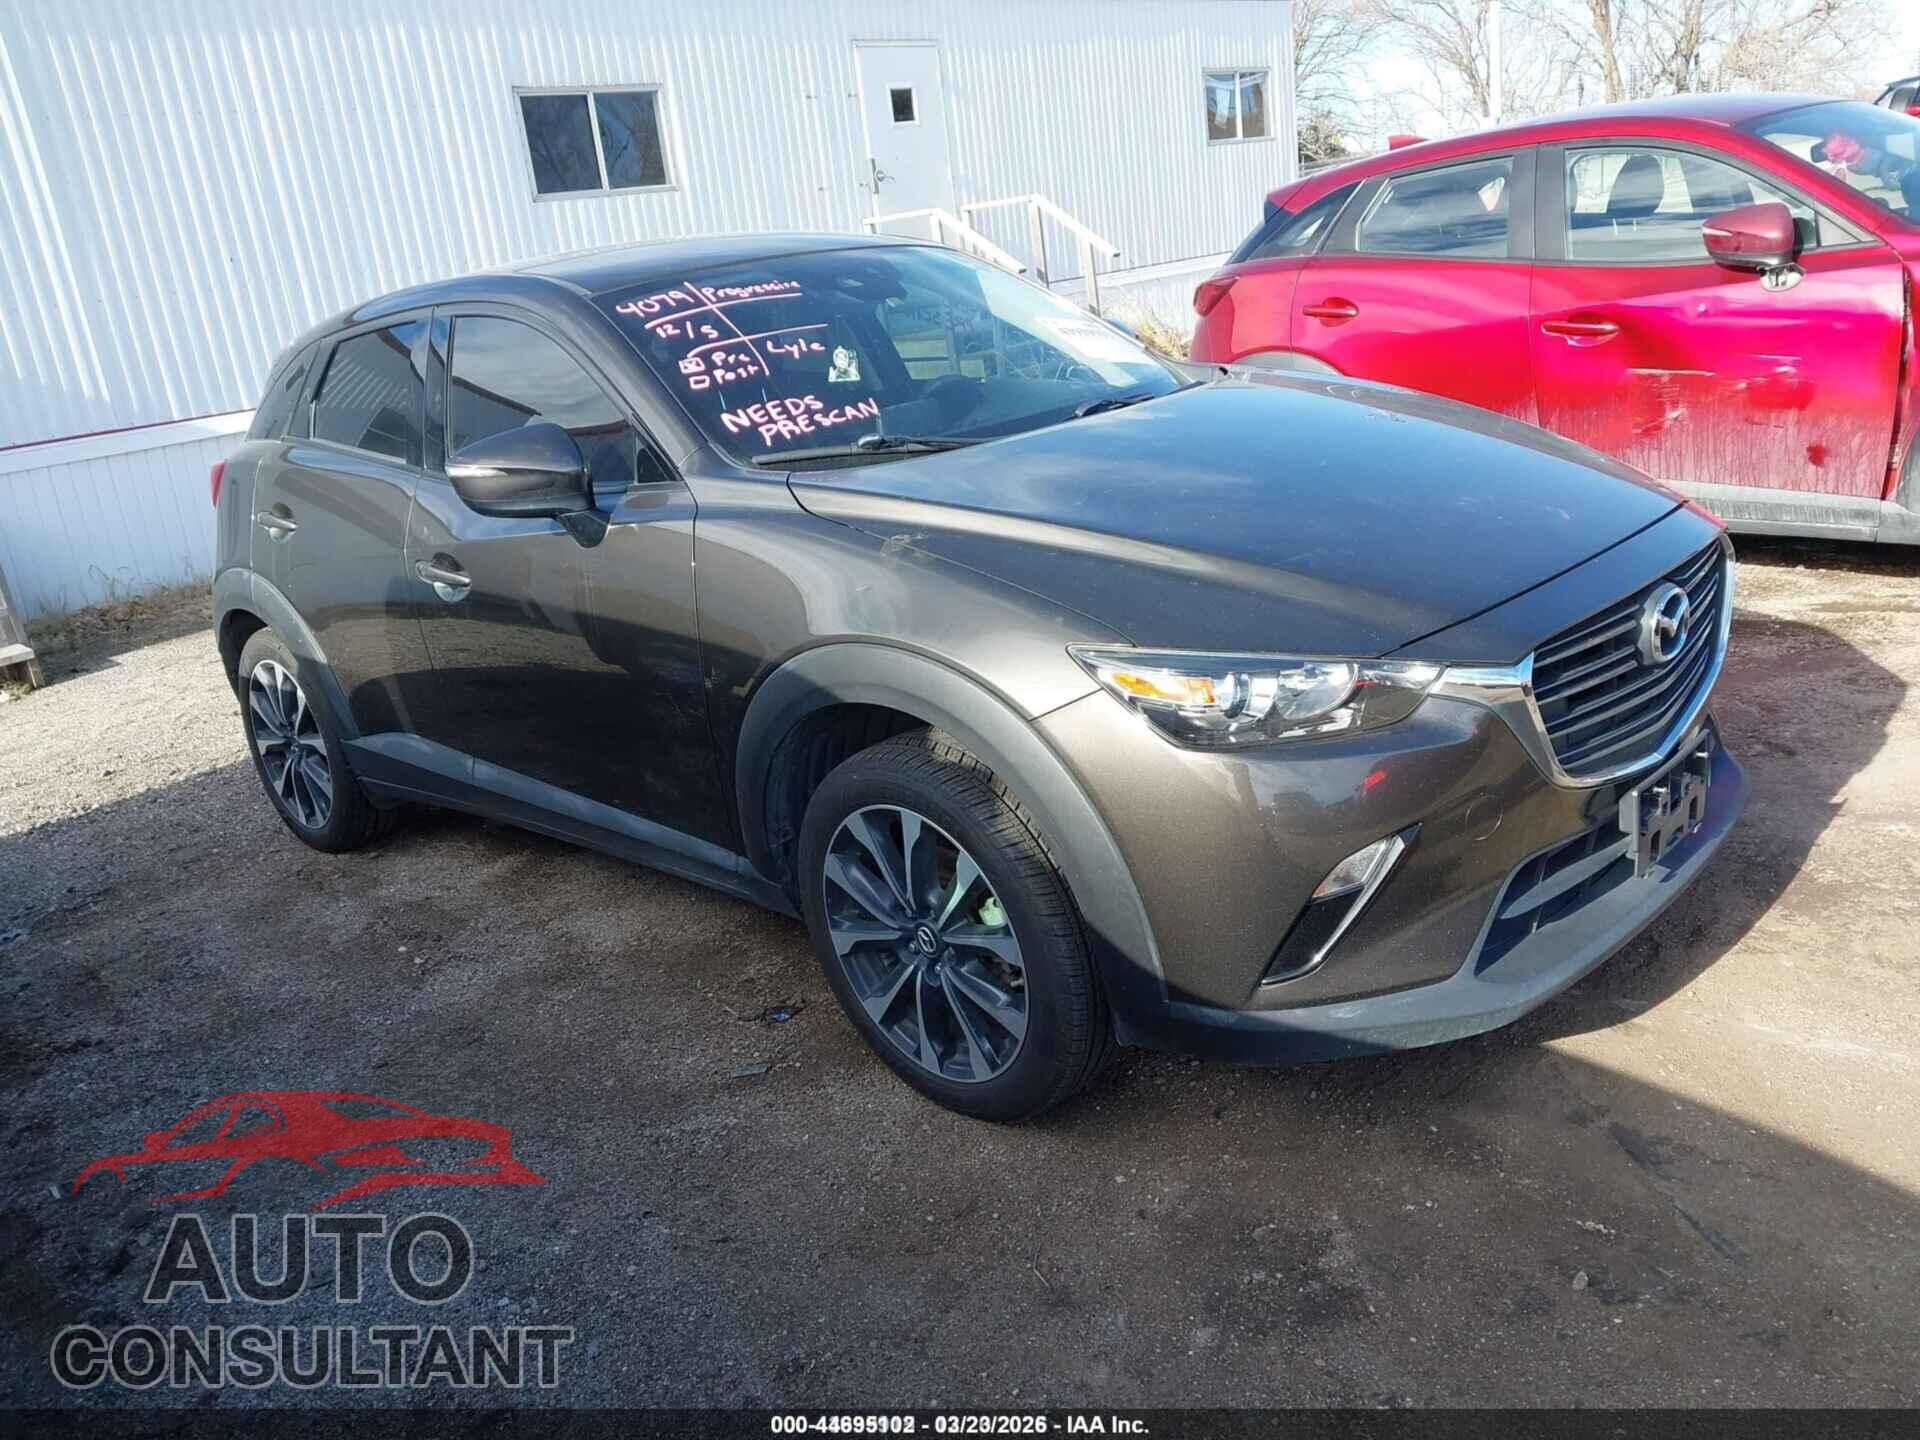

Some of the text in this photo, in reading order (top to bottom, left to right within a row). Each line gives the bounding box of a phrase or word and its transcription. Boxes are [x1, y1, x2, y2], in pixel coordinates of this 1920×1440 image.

[615, 290, 695, 318] 4079
[720, 394, 824, 433] NEEDS
[757, 397, 880, 447] PRESCAN
